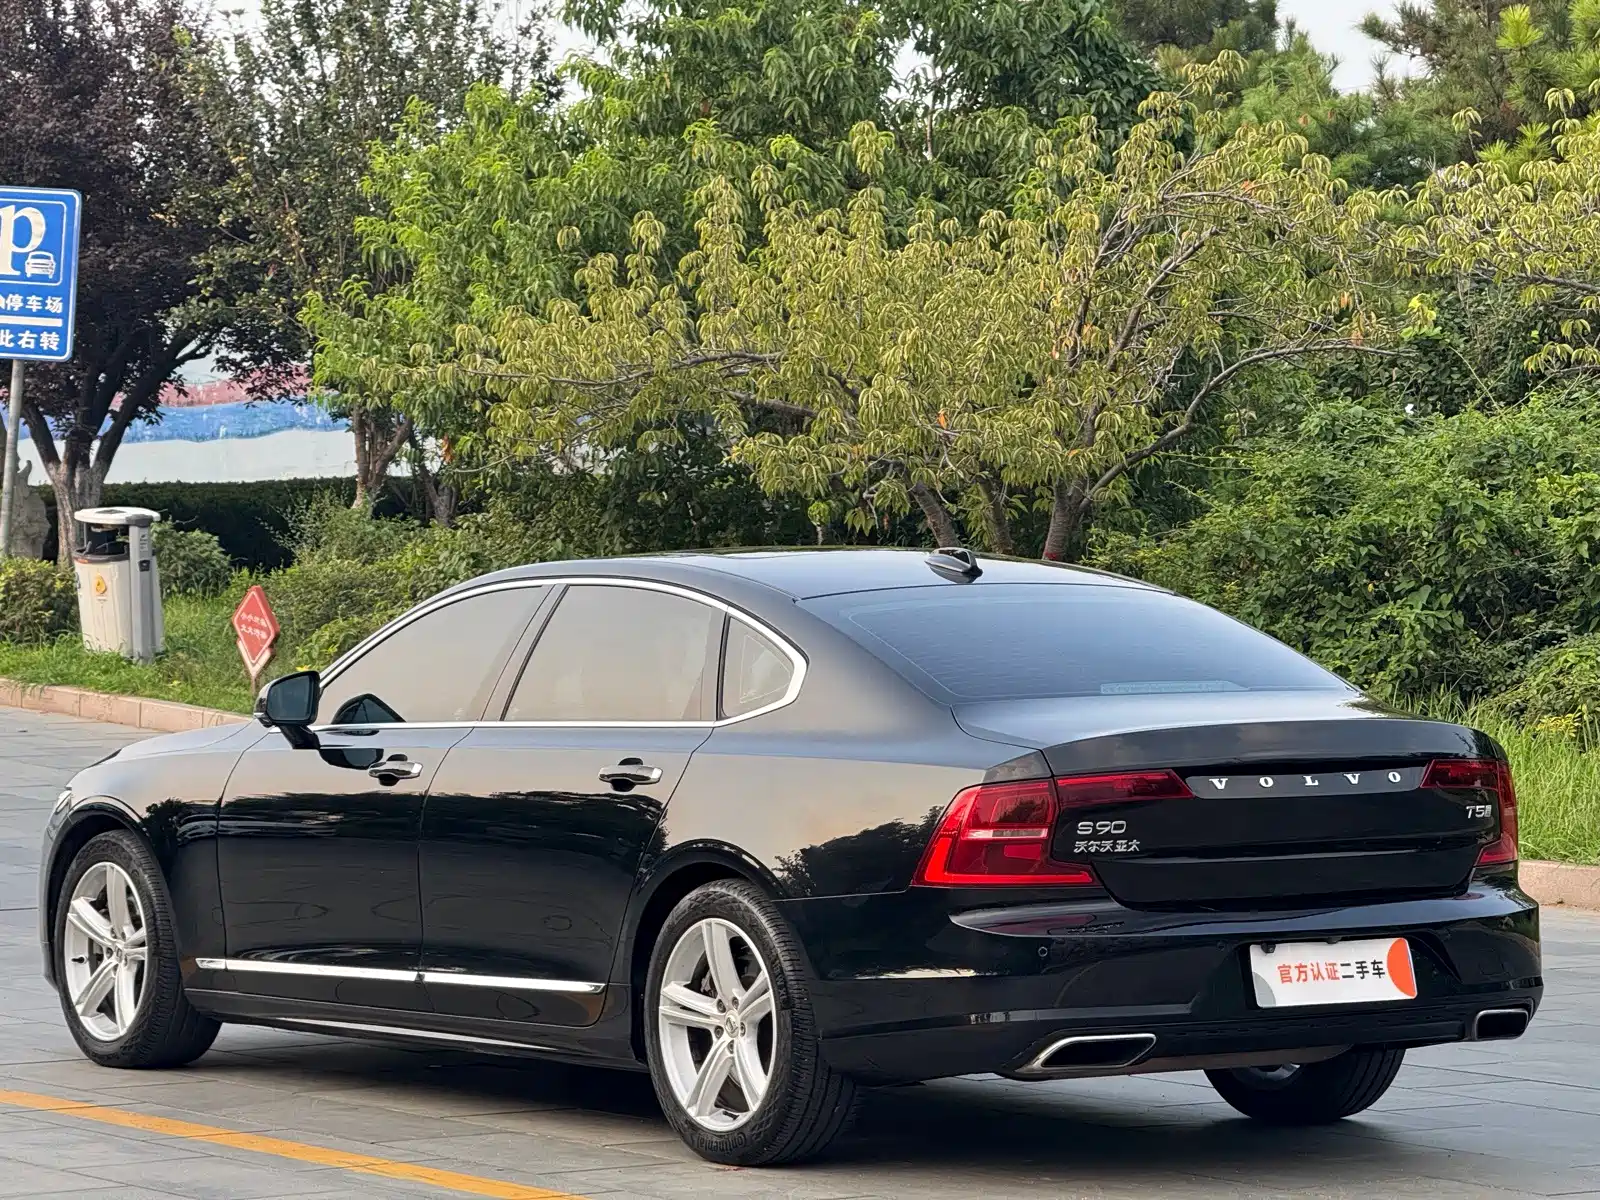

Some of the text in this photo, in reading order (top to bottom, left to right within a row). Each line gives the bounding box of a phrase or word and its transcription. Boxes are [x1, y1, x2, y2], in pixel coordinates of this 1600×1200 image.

[1209, 771, 1401, 791] VOLVO
[1076, 820, 1127, 835] S90
[1073, 839, 1141, 853] 沃尔沃亚太
[1277, 959, 1386, 984] 官方认证二手车
